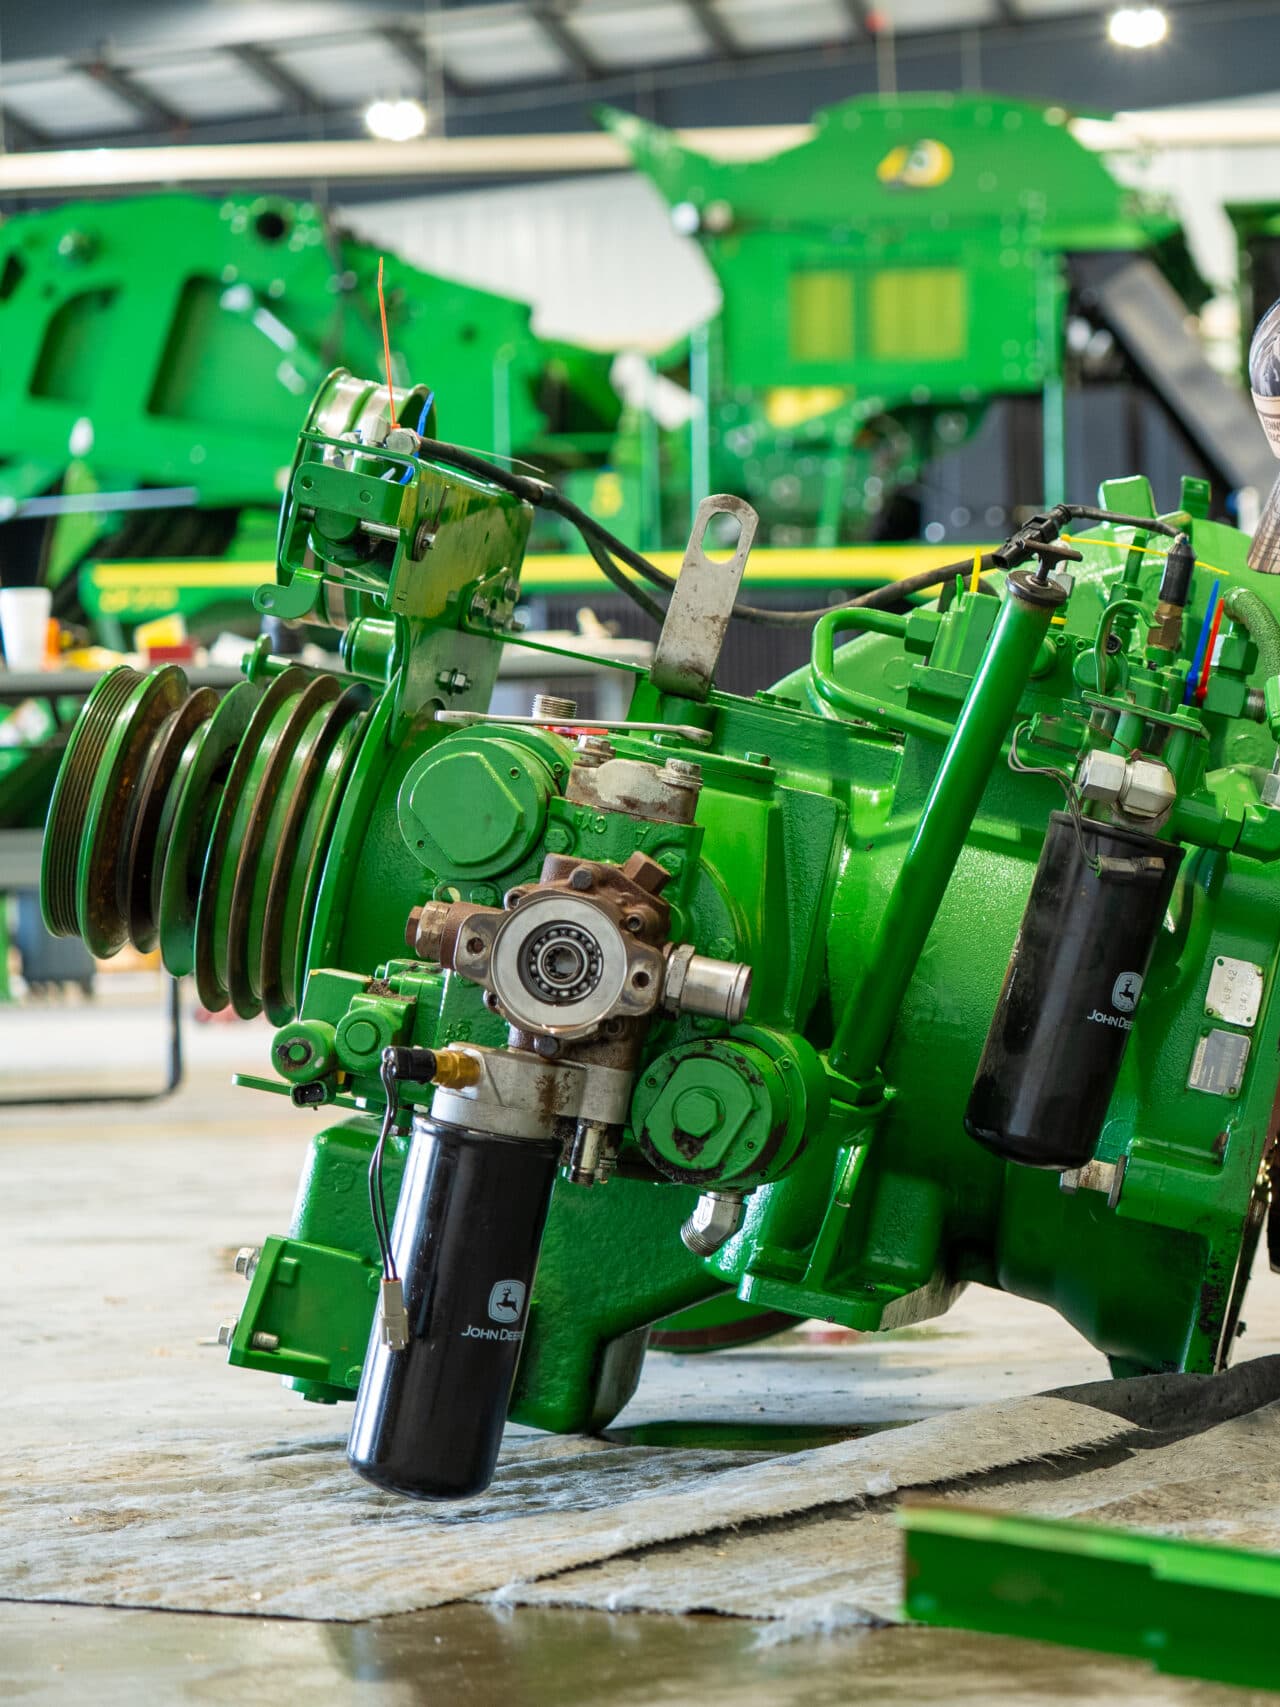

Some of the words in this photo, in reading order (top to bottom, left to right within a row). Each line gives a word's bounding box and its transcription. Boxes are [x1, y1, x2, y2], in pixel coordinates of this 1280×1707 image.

[1086, 1009, 1119, 1027] JOHN
[1118, 1016, 1134, 1030] DEE
[461, 1324, 499, 1340] JOHN
[500, 1328, 524, 1341] DEE
